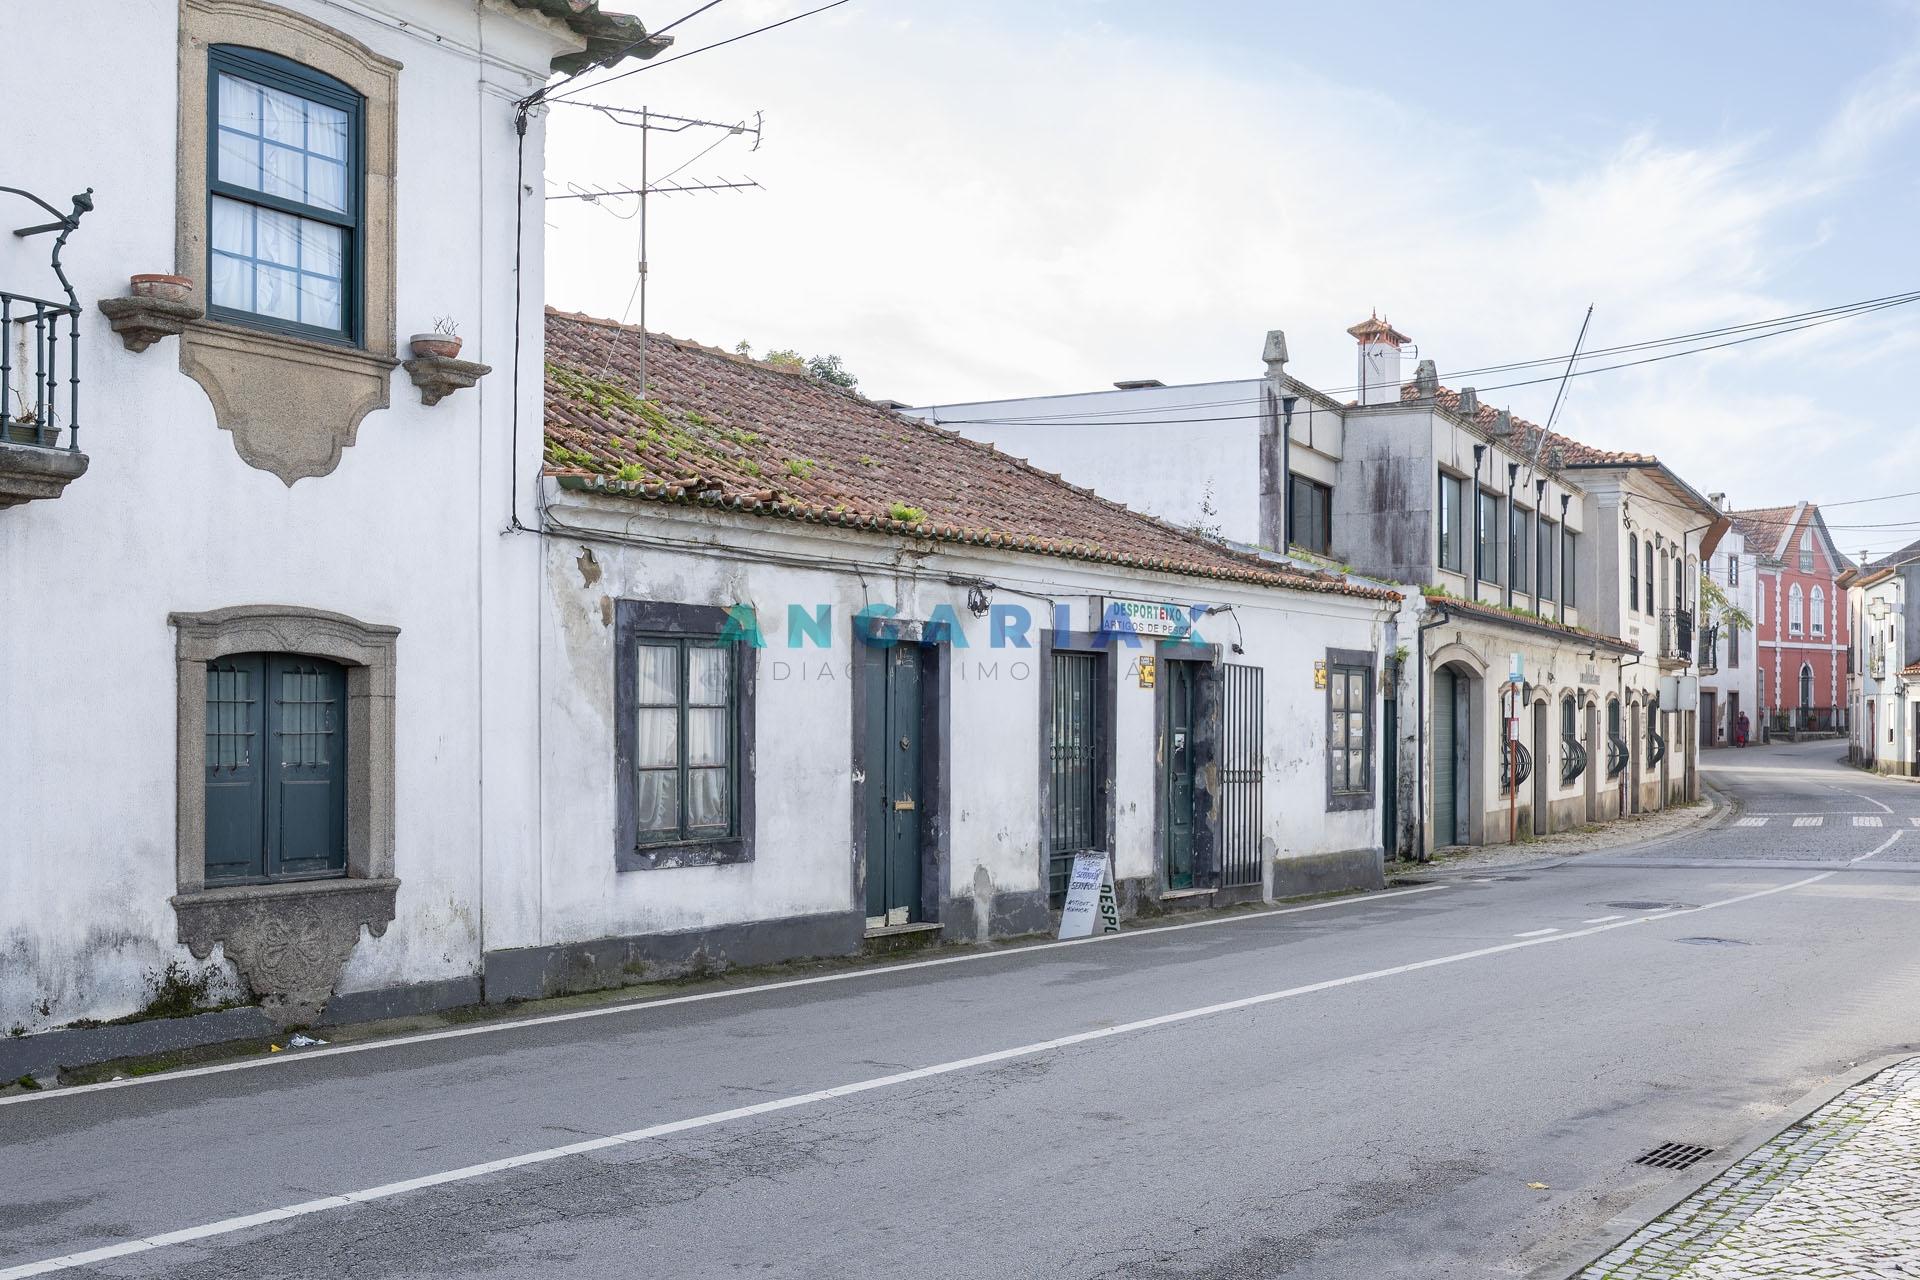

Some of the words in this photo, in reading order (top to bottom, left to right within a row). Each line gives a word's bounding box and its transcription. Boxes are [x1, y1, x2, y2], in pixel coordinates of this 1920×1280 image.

[1113, 602, 1182, 621] DESPORTEIXO
[1104, 618, 1144, 632] ARTIGOS
[1147, 623, 1159, 633] DE
[1162, 625, 1190, 637] PESCA
